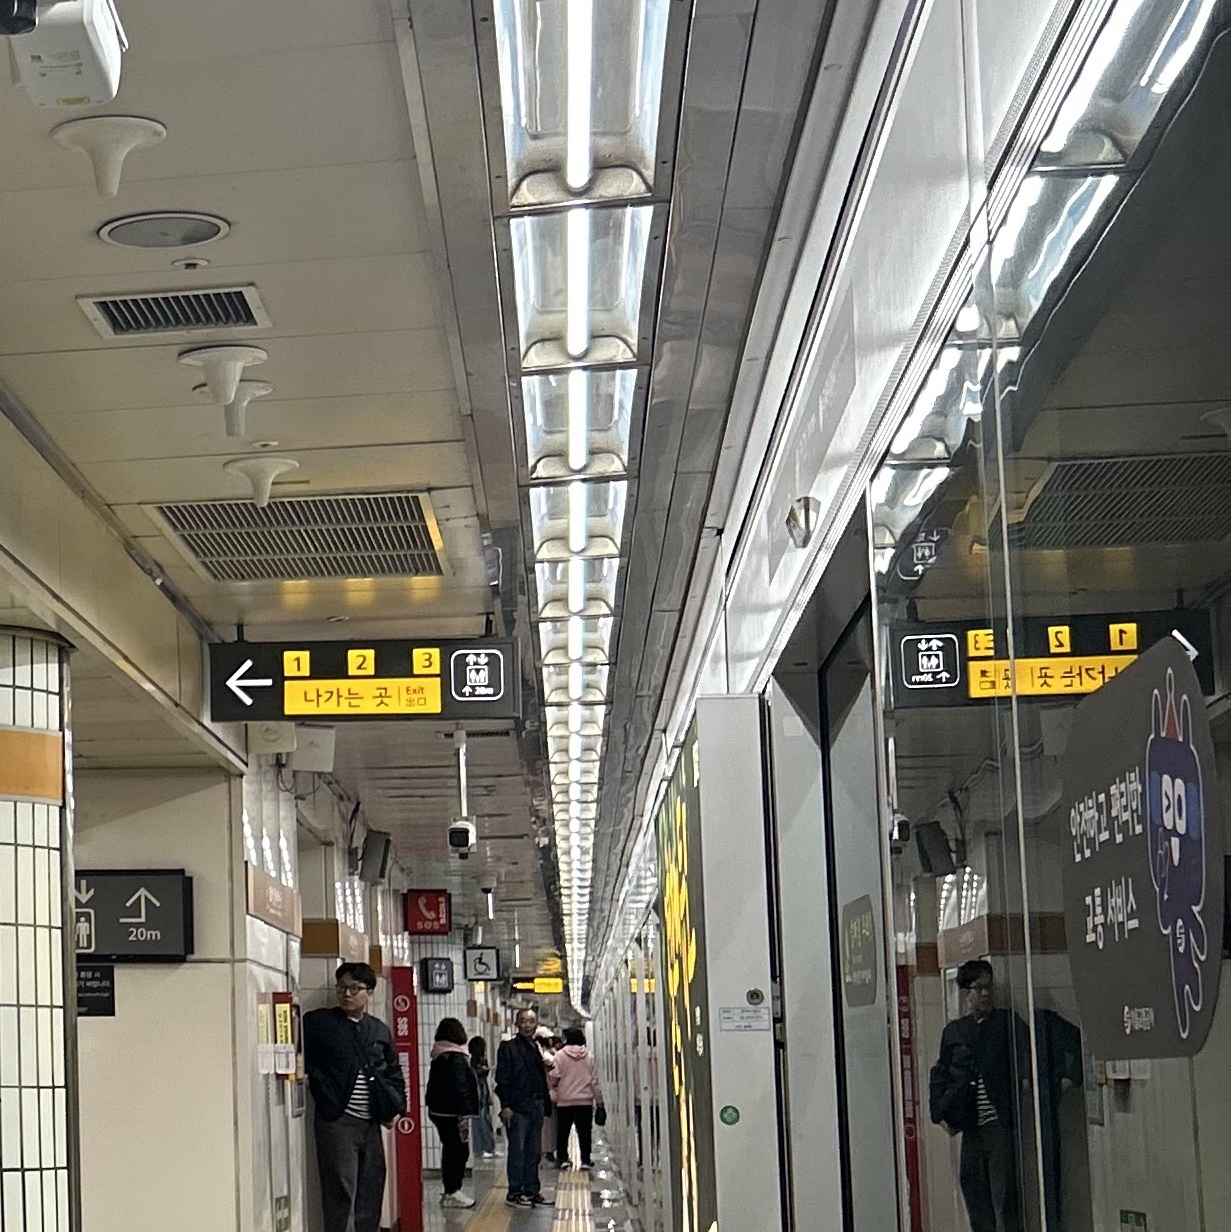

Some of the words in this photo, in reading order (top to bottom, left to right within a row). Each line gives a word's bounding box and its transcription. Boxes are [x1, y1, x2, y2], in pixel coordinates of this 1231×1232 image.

[292, 656, 302, 672] 1
[356, 655, 368, 671] 2
[422, 652, 433, 669] 3
[303, 687, 364, 709] 나가는
[372, 687, 392, 708] 곳
[405, 685, 425, 696] Exit
[1070, 790, 1110, 863] 안전하고
[1110, 765, 1144, 844] 편리한
[1085, 886, 1106, 950] 교통
[1107, 875, 1140, 942] 서비스
[128, 927, 161, 942] 20m
